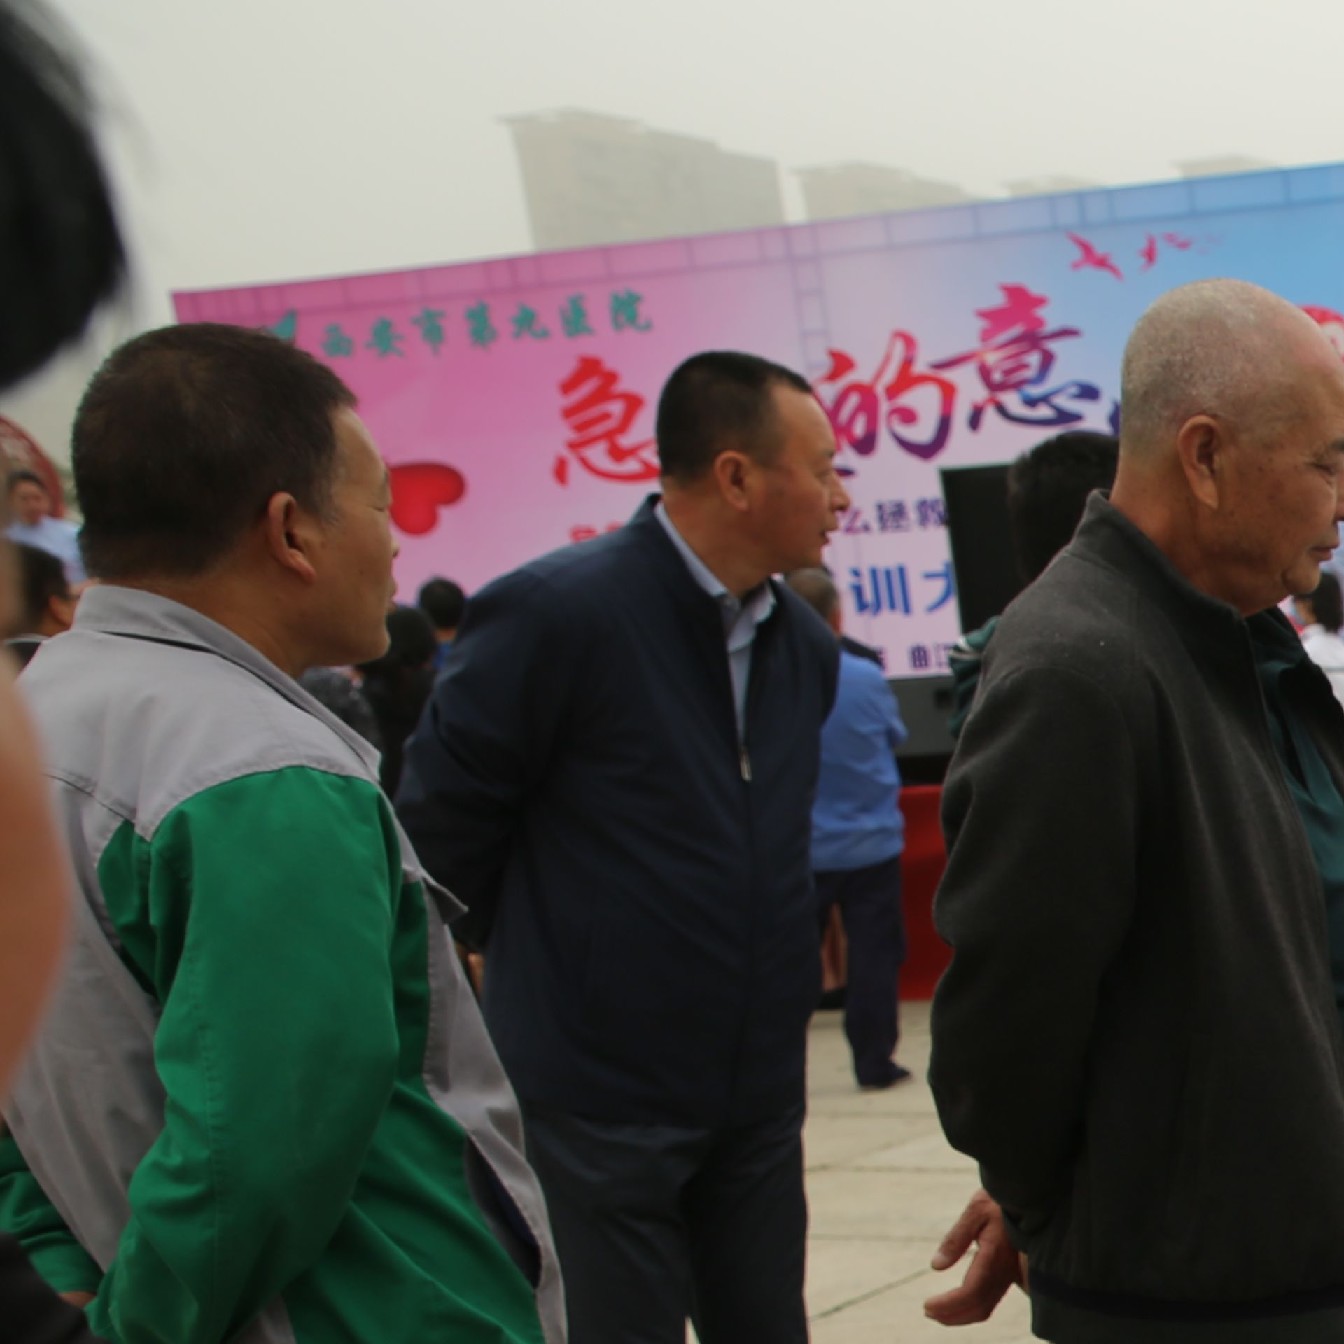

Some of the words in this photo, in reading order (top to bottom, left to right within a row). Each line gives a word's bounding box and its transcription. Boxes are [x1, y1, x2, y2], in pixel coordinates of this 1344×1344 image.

[320, 288, 653, 358] 西安市第九医院
